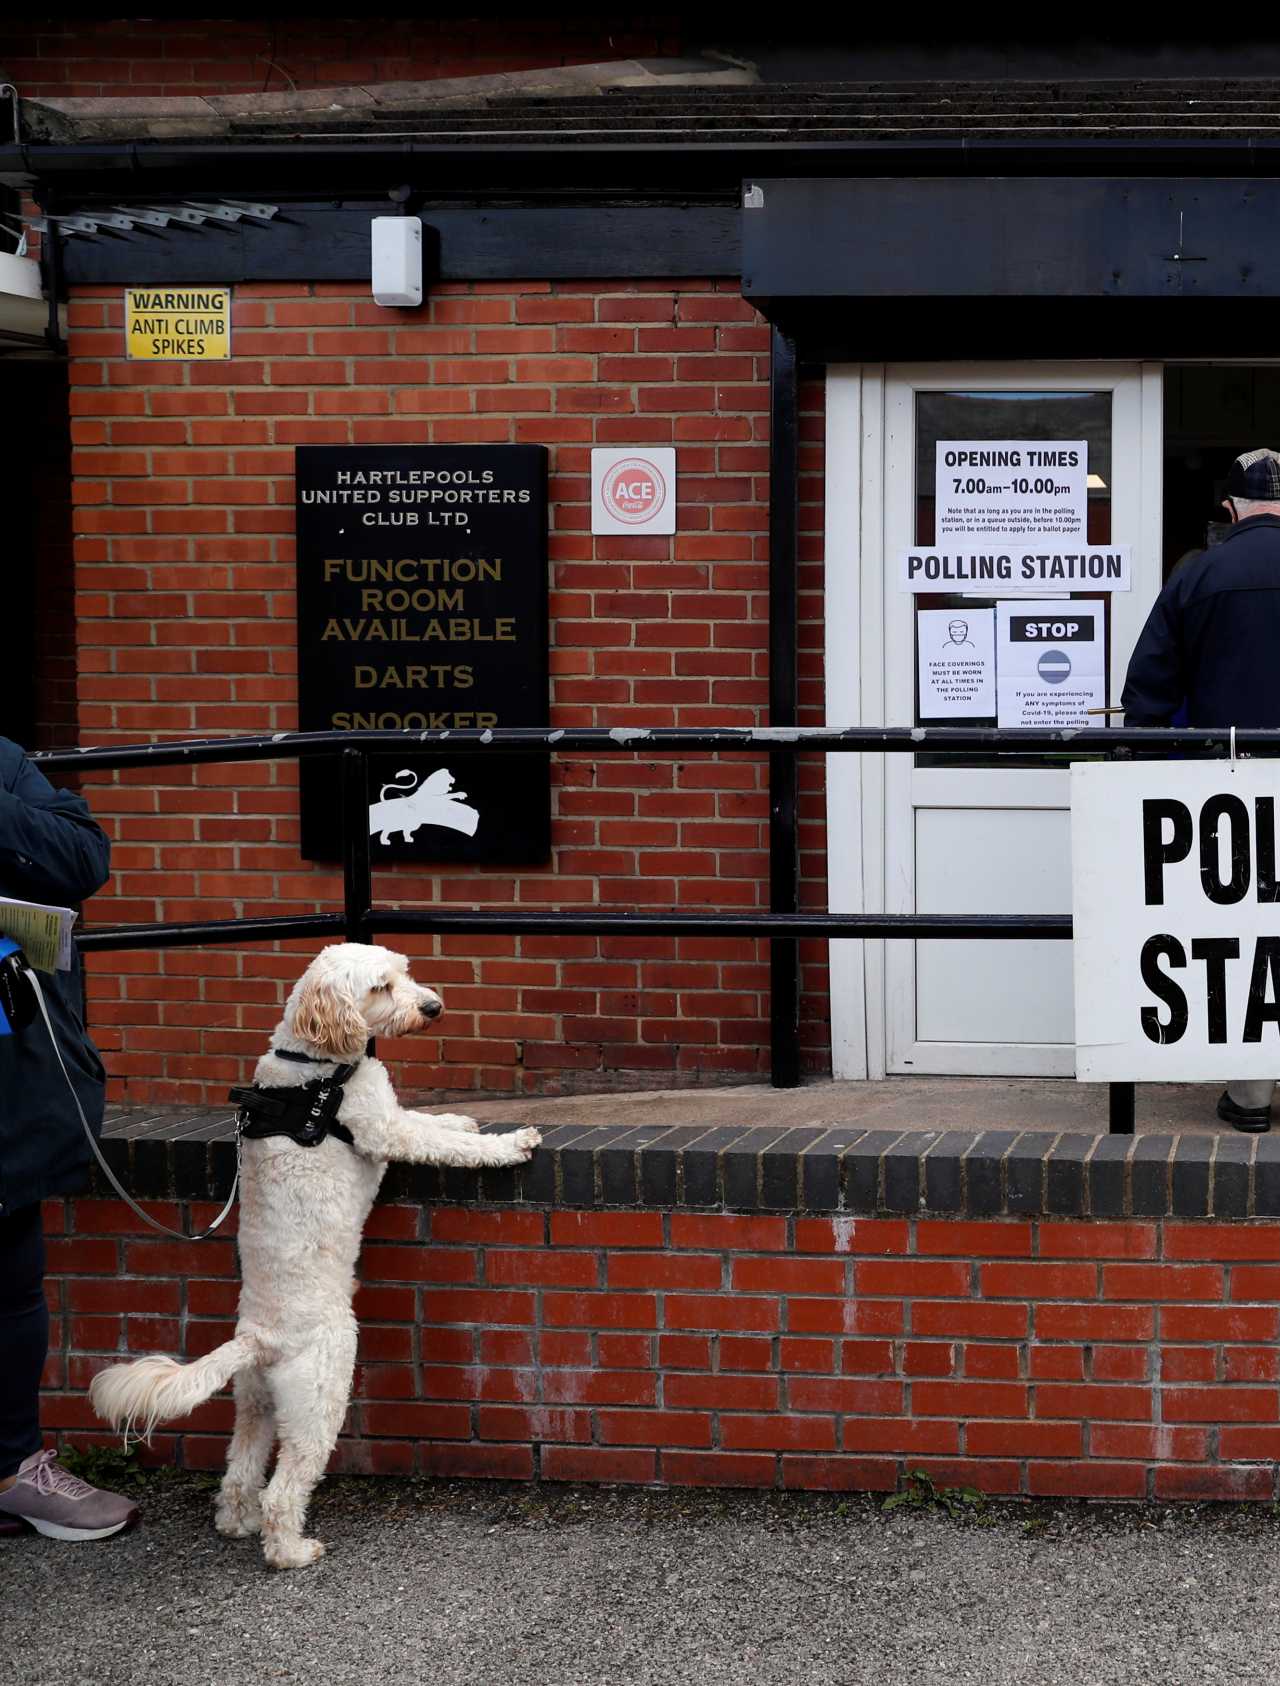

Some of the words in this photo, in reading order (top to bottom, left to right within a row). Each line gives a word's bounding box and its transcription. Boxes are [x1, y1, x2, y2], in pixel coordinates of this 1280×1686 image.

[132, 293, 224, 310] WARNING
[131, 319, 169, 335] ANTI
[175, 319, 225, 335] CLIMB
[152, 339, 205, 355] SPIKES
[944, 451, 1021, 467] OPENING
[1027, 451, 1079, 467] TIMES
[336, 470, 494, 485] HARTLEPOOLS
[301, 490, 381, 504] UNITED
[388, 490, 531, 504] SUPPORTERS
[615, 482, 652, 500] ACE
[362, 512, 419, 526] CLUB
[428, 512, 469, 526] LTD
[987, 507, 1000, 515] long
[1053, 507, 1075, 515] polling
[941, 516, 965, 524] station,
[1007, 516, 1032, 524] outside,
[1055, 516, 1081, 524] 10.00pm
[1009, 525, 1026, 533] apply
[323, 559, 502, 582] FUNCTION
[907, 555, 1012, 580] POLLING
[1021, 554, 1122, 579] STATION
[361, 589, 465, 612] ROOM
[320, 617, 517, 642] AVAILABLE
[1025, 623, 1079, 638] STOP
[354, 665, 475, 689] DARTS
[331, 712, 498, 730] SNOOKER
